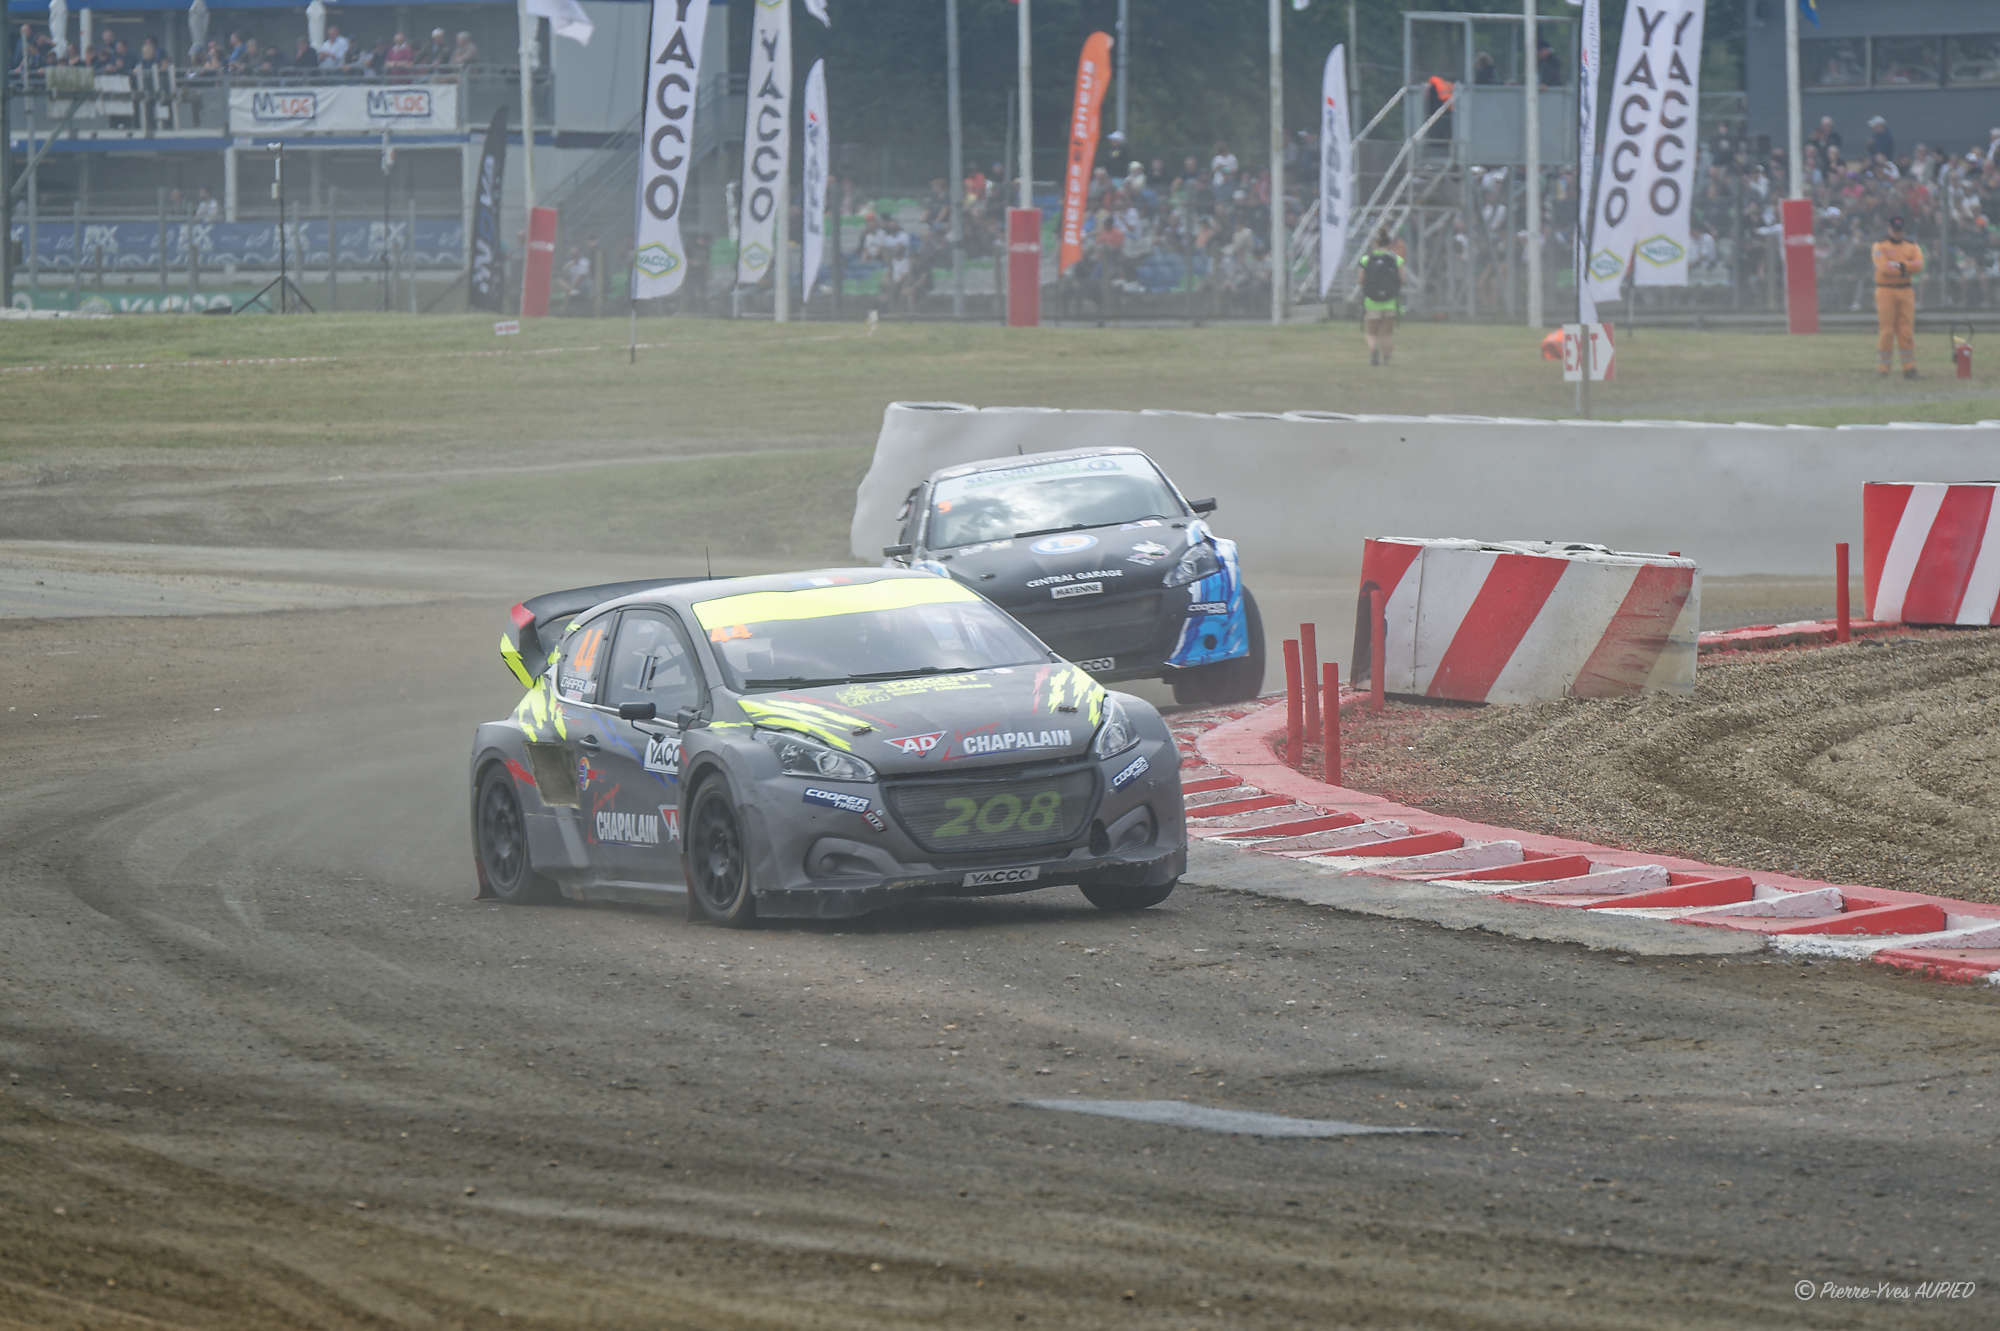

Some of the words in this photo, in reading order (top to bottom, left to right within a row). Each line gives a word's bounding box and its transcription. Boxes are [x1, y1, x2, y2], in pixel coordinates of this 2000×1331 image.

[645, 0, 695, 221] YACCO
[752, 28, 784, 222] YACCO
[1604, 6, 1668, 228] YACCO
[1649, 11, 1695, 216] YACCO
[1565, 332, 1599, 372] EXT
[1026, 574, 1075, 588] CENTRAL
[1075, 569, 1125, 580] GARAGE
[650, 742, 679, 767] YACC
[902, 736, 937, 754] AD
[963, 729, 1072, 754] CHAPALAIN
[1112, 756, 1147, 786] COOPER
[805, 787, 870, 807] COOPER
[596, 811, 659, 844] CHAPALAIN
[667, 811, 680, 842] A
[932, 790, 1062, 838] 208
[971, 868, 1033, 884] YACCO
